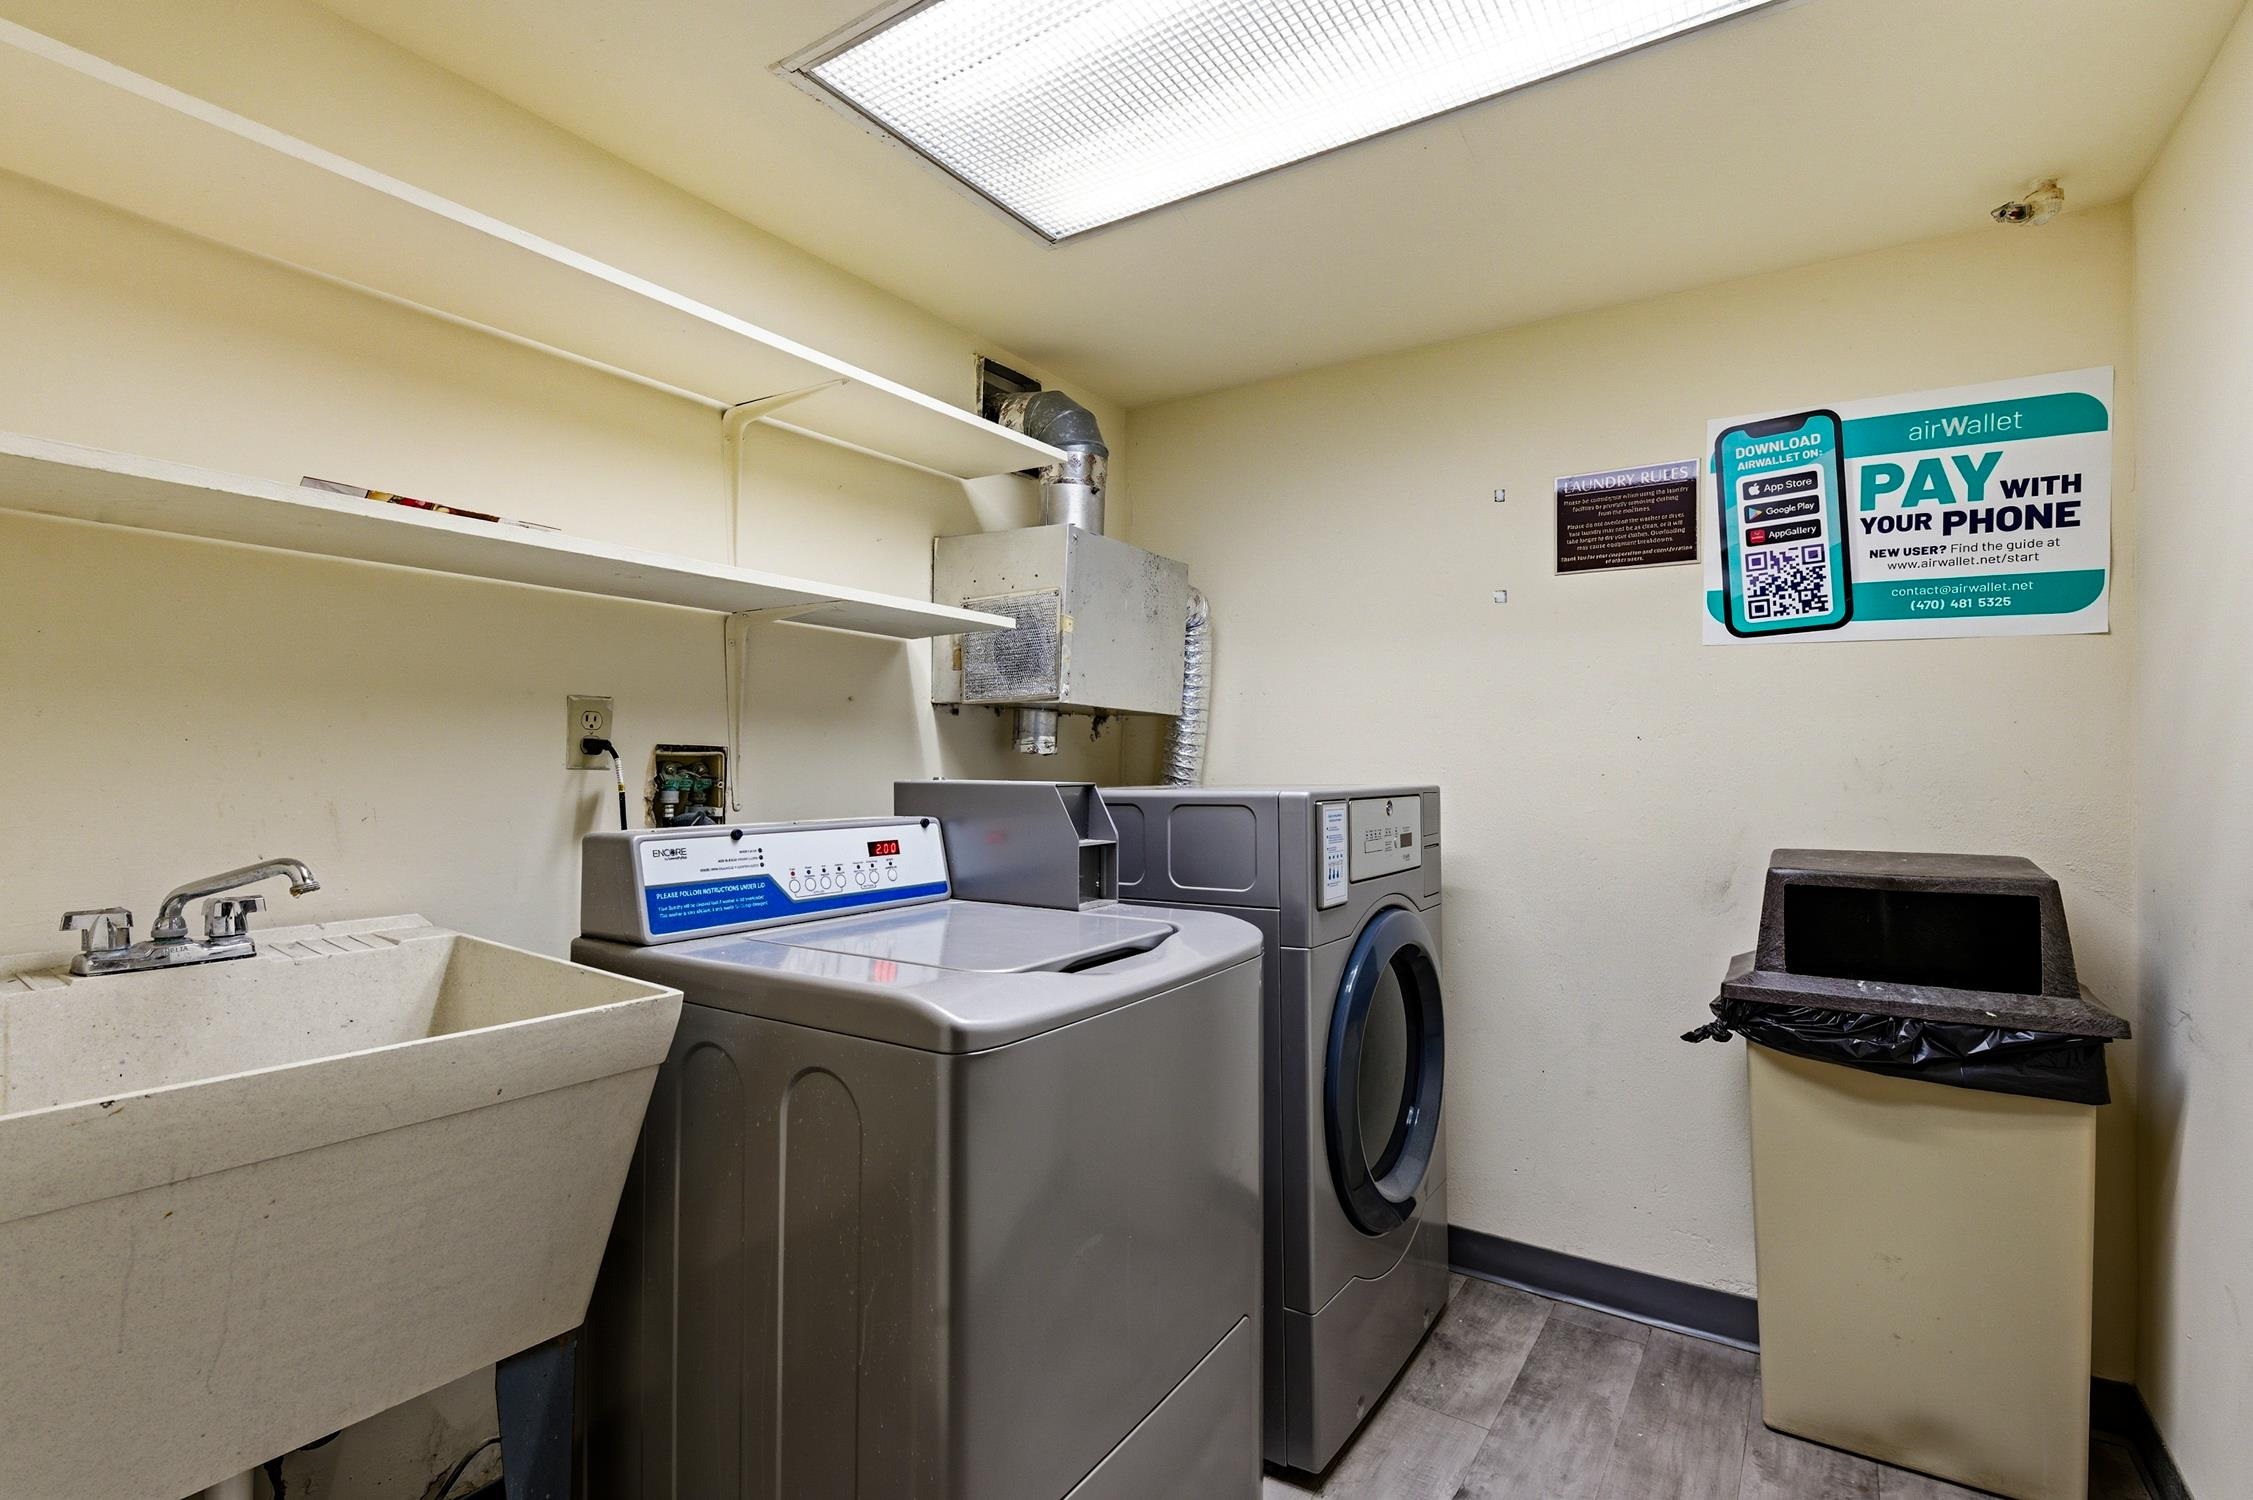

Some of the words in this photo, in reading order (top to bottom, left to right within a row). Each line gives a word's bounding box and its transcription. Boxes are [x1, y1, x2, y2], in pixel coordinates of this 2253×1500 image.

[1908, 411, 2023, 441] airWallet
[1735, 433, 1821, 460] DOWNLOAD
[1737, 453, 1799, 471] AIRWALLET
[1802, 449, 1823, 459] ON:
[1564, 473, 1635, 493] LAUNDRY
[1640, 466, 1689, 484] RULES
[1763, 483, 1784, 493] App
[1786, 477, 1812, 487] Store
[1859, 450, 2004, 512] PAY
[2000, 473, 2082, 500] WITH
[1765, 504, 1797, 516] Google
[1797, 501, 1815, 511] Play
[1860, 512, 1933, 535] YOUR
[1942, 500, 2081, 537] PHONE
[1768, 526, 1817, 539] AppGallery
[1869, 547, 1900, 559] NEW
[1903, 544, 1947, 557] USER?
[1950, 543, 1978, 554] Find
[1982, 540, 2003, 552] the
[2006, 538, 2044, 553] guide
[2047, 537, 2060, 548] at
[1887, 552, 2040, 570] www.airwallet.net/start
[1891, 581, 2034, 597] contact@airwallet.net
[1910, 598, 1945, 612] (470)
[1950, 598, 1973, 609] 481
[1978, 596, 2011, 608] 5325
[656, 891, 679, 900] PLEASE
[702, 884, 739, 895] INSTRUCTIONS
[739, 883, 757, 891] UNDER
